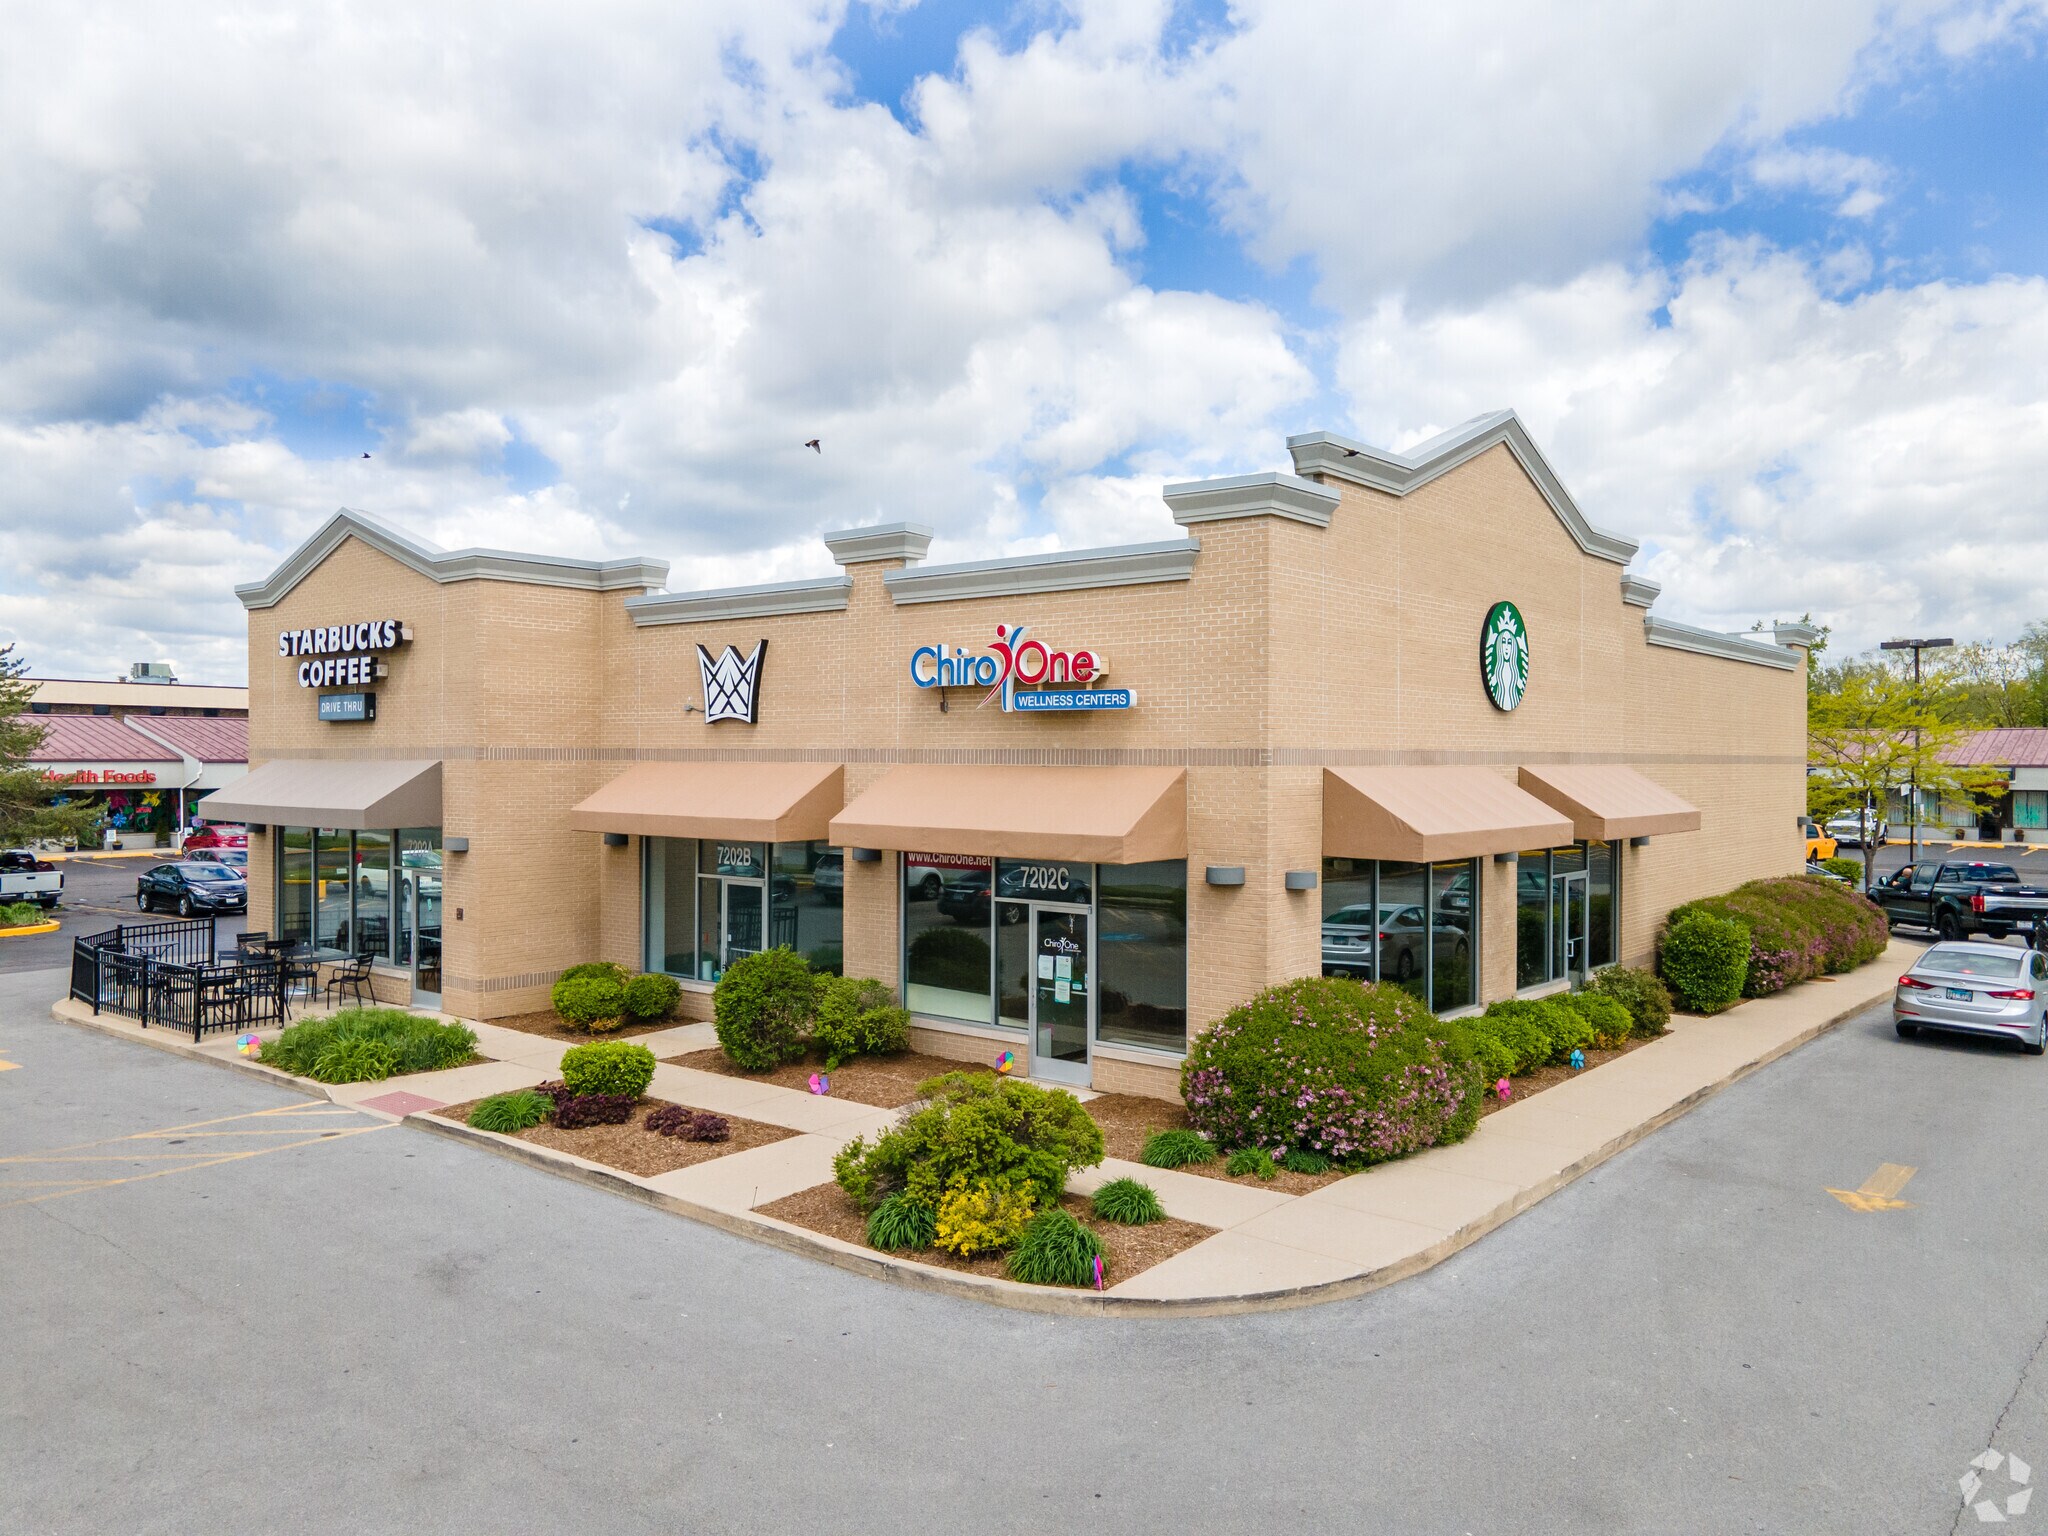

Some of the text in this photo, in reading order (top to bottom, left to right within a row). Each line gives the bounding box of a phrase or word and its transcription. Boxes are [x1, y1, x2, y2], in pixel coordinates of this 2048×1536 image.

[279, 619, 397, 657] STARBUCKS
[298, 656, 372, 688] COFFEE
[910, 640, 1096, 689] Chiro One
[321, 701, 363, 713] DRIVE THRU
[1018, 693, 1127, 707] WELLNESS CENTERS
[103, 769, 157, 783] Foods
[717, 846, 752, 866] 7202B
[908, 852, 991, 866] www.ChiroOne.net
[1020, 866, 1069, 891] 7202C
